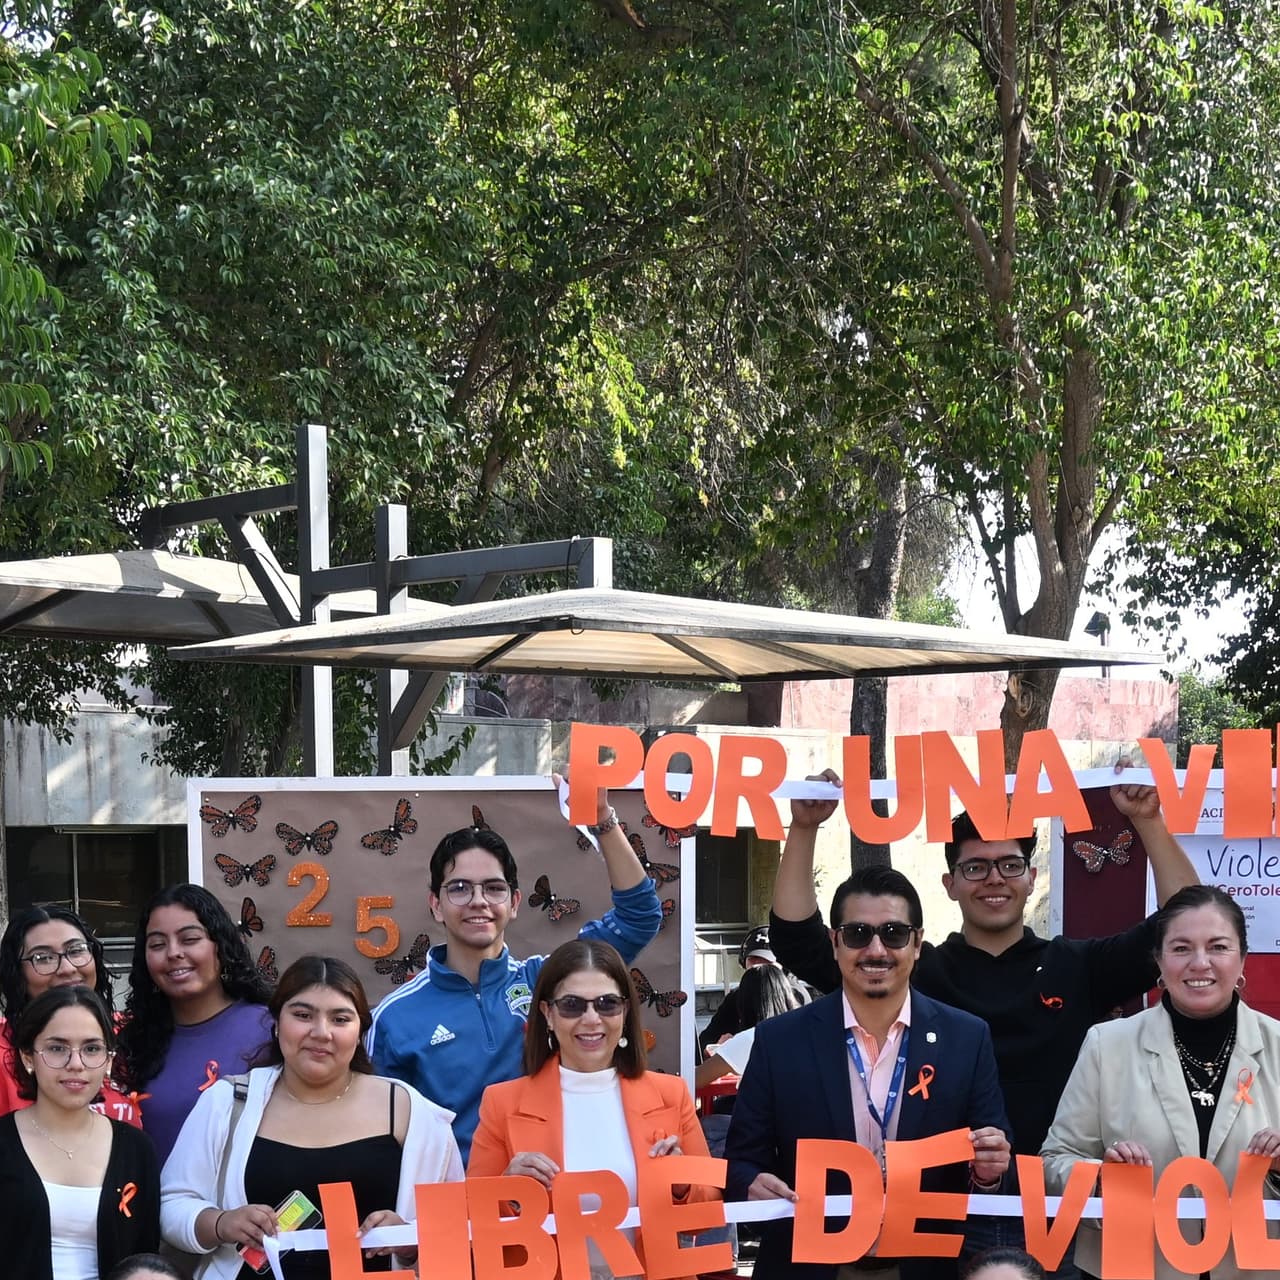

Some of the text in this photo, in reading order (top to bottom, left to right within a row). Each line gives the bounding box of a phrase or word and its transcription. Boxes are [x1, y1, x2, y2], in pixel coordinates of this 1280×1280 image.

[568, 722, 786, 841] POR
[842, 728, 1094, 845] UNA
[791, 1126, 976, 1265] DE
